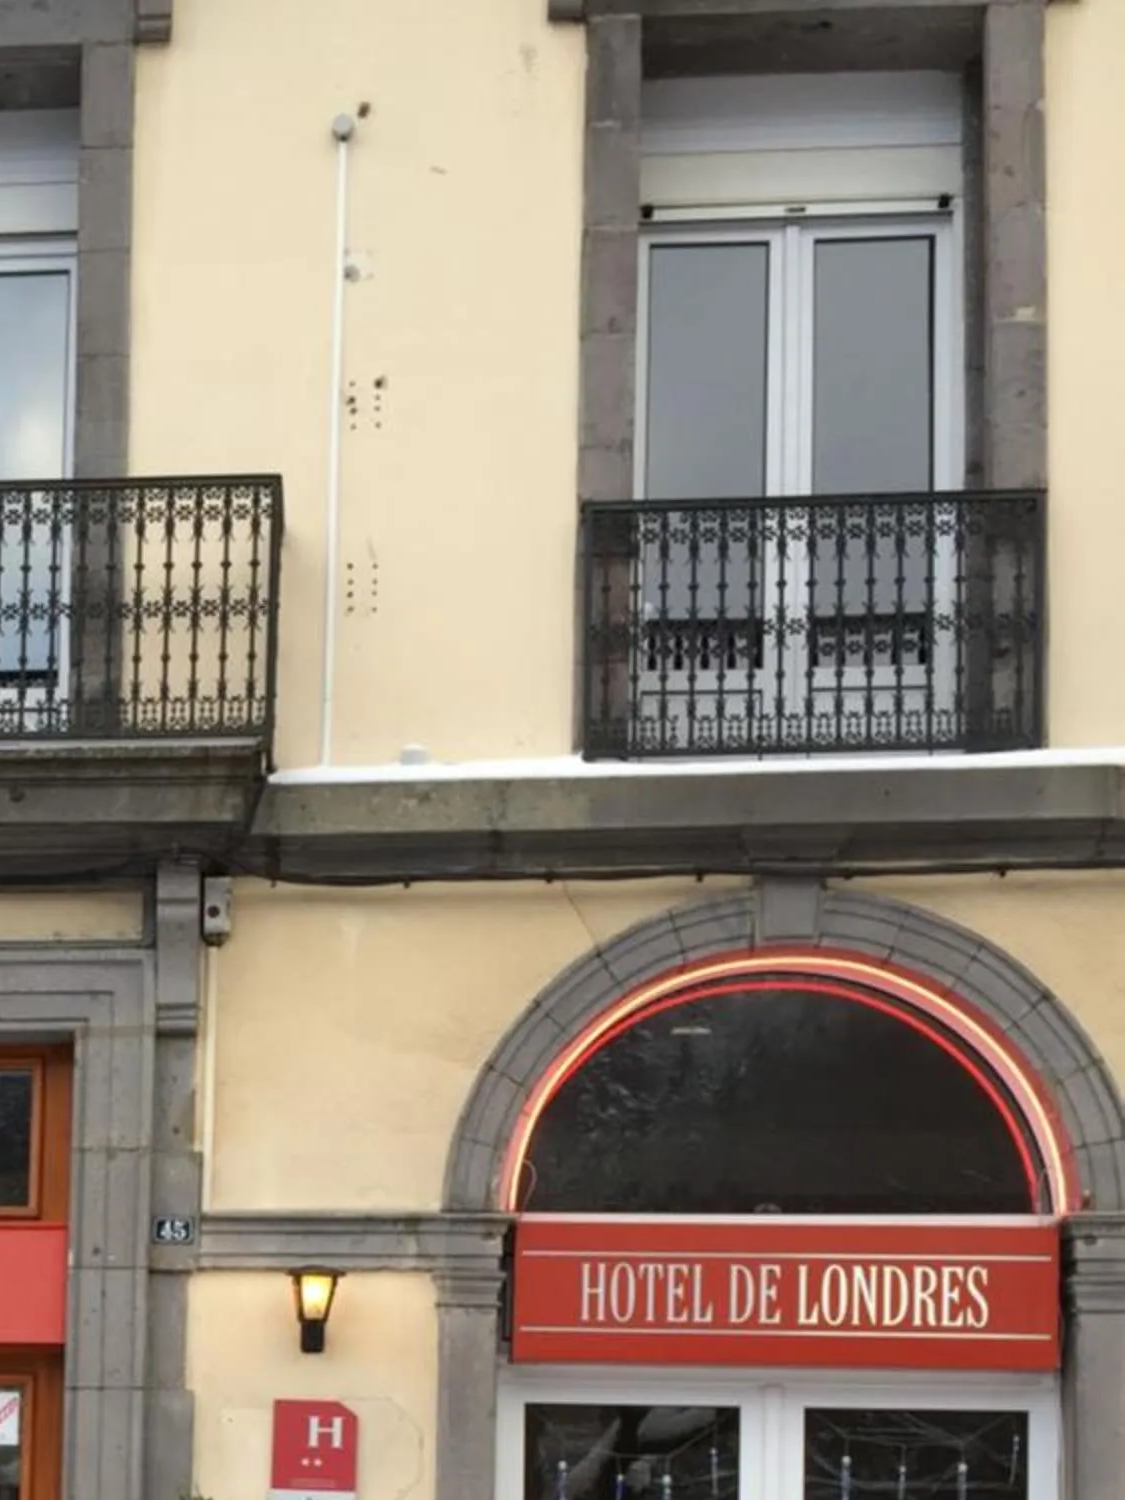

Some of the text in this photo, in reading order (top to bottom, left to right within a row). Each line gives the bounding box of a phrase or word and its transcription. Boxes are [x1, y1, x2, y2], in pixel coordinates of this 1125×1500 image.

[160, 1219, 187, 1240] 45
[580, 1262, 989, 1328] HOTEL DE LONDRES
[308, 1415, 343, 1448] H
